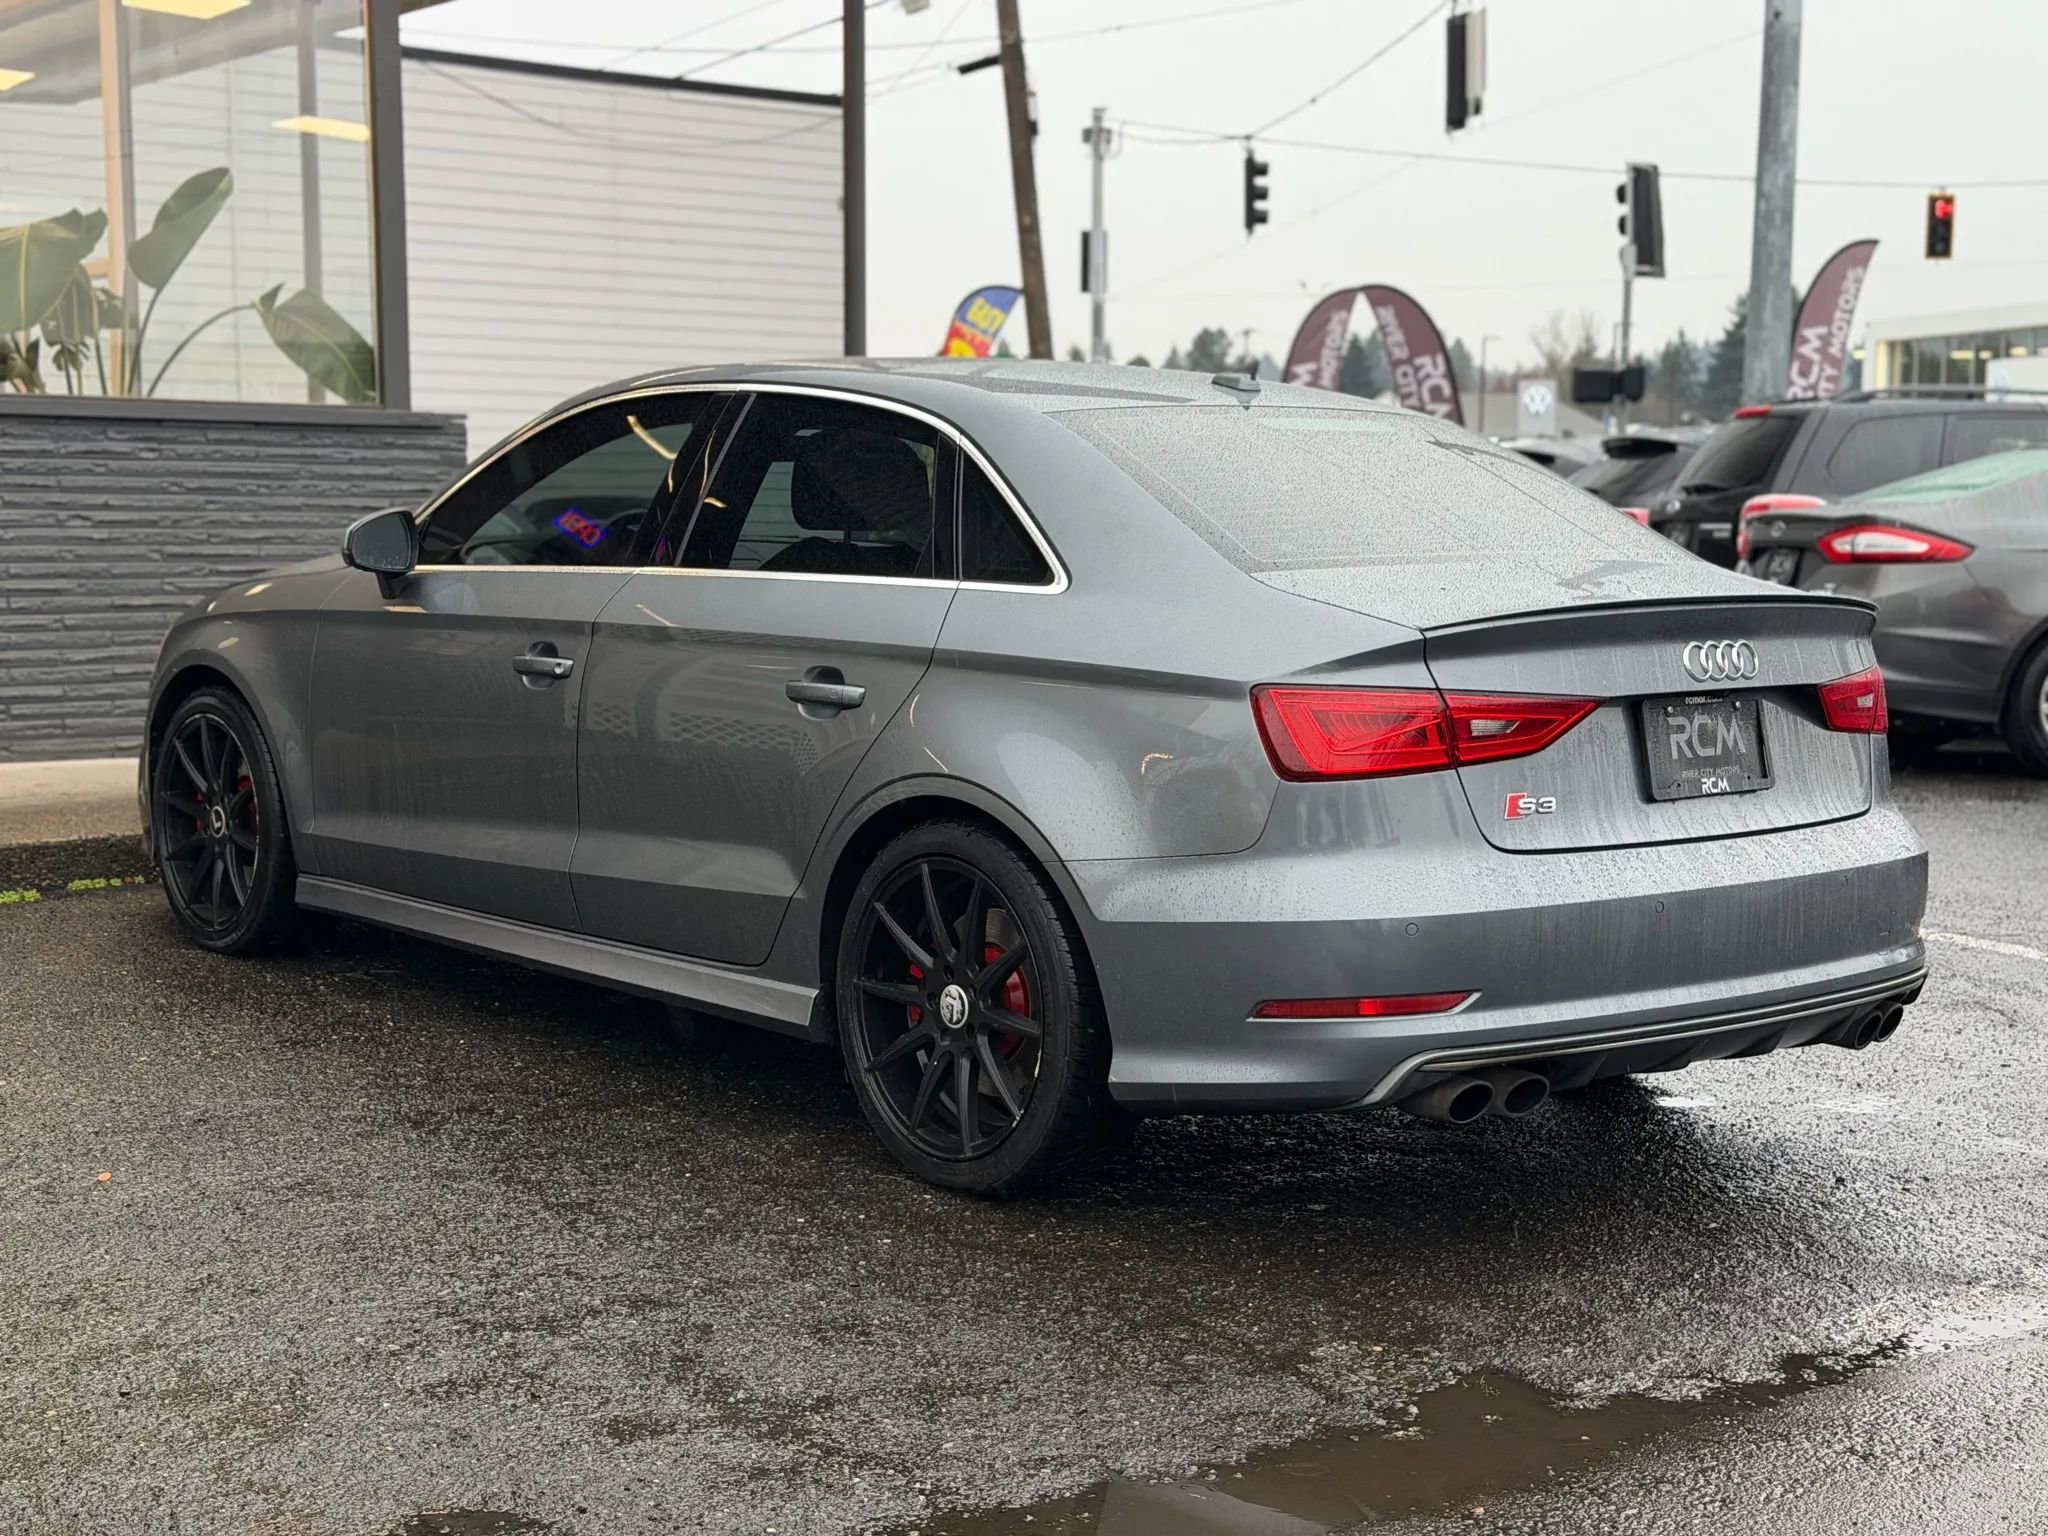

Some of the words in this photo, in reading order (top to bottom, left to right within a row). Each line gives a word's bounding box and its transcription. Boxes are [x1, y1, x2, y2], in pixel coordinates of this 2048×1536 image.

[1375, 304, 1409, 360] RIVER
[1829, 267, 1864, 358] MOTORS
[1786, 325, 1829, 399] RCM
[1818, 362, 1841, 399] ITY
[1667, 714, 1747, 760] RCM
[1681, 769, 1699, 778] RIVER
[1700, 768, 1713, 776] CITY
[1715, 765, 1741, 775] MOTORS
[1701, 777, 1730, 794] RCM
[1516, 796, 1556, 816] S3
